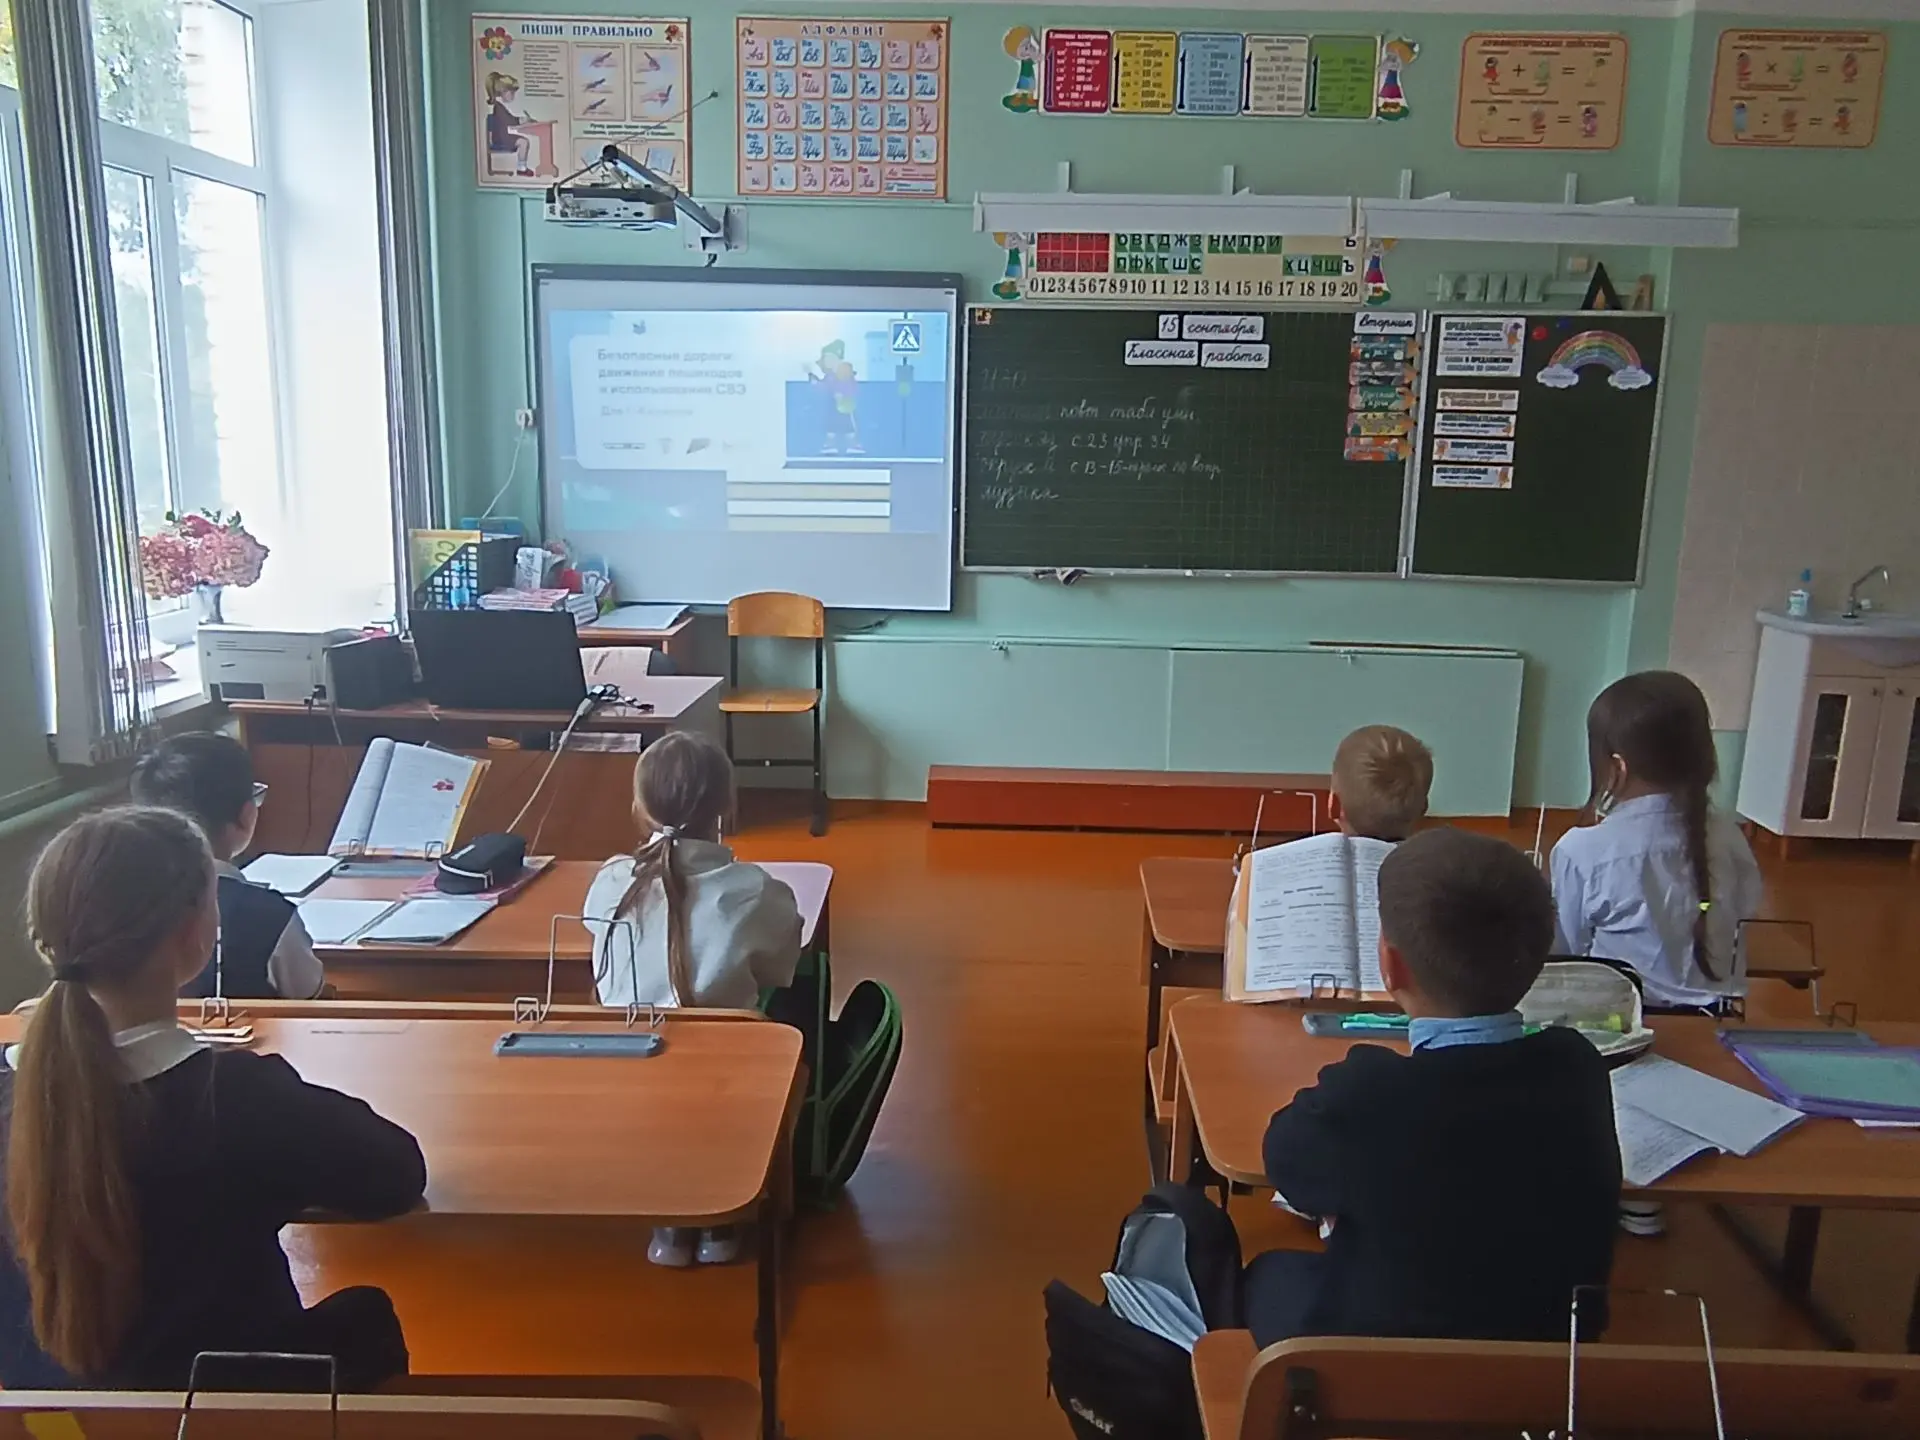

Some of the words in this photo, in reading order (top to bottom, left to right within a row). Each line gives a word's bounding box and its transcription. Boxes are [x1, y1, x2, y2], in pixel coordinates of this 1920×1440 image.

[521, 24, 563, 35] ПИШИ
[572, 25, 653, 37] ПРАВИЛЬНО
[800, 25, 884, 37] АЛФАВИТ
[1132, 279, 1146, 294] 10
[1152, 279, 1165, 294] 11
[1173, 280, 1188, 294] 12
[1194, 280, 1209, 295] 13
[1215, 281, 1230, 295] 14
[1236, 281, 1251, 296] 15
[1257, 281, 1272, 296] 16
[1278, 281, 1294, 296] 17
[1300, 281, 1315, 296] 18
[1320, 281, 1336, 296] 19
[1341, 281, 1358, 296] 20
[1161, 316, 1177, 333] 15
[1127, 343, 1196, 359] Классная
